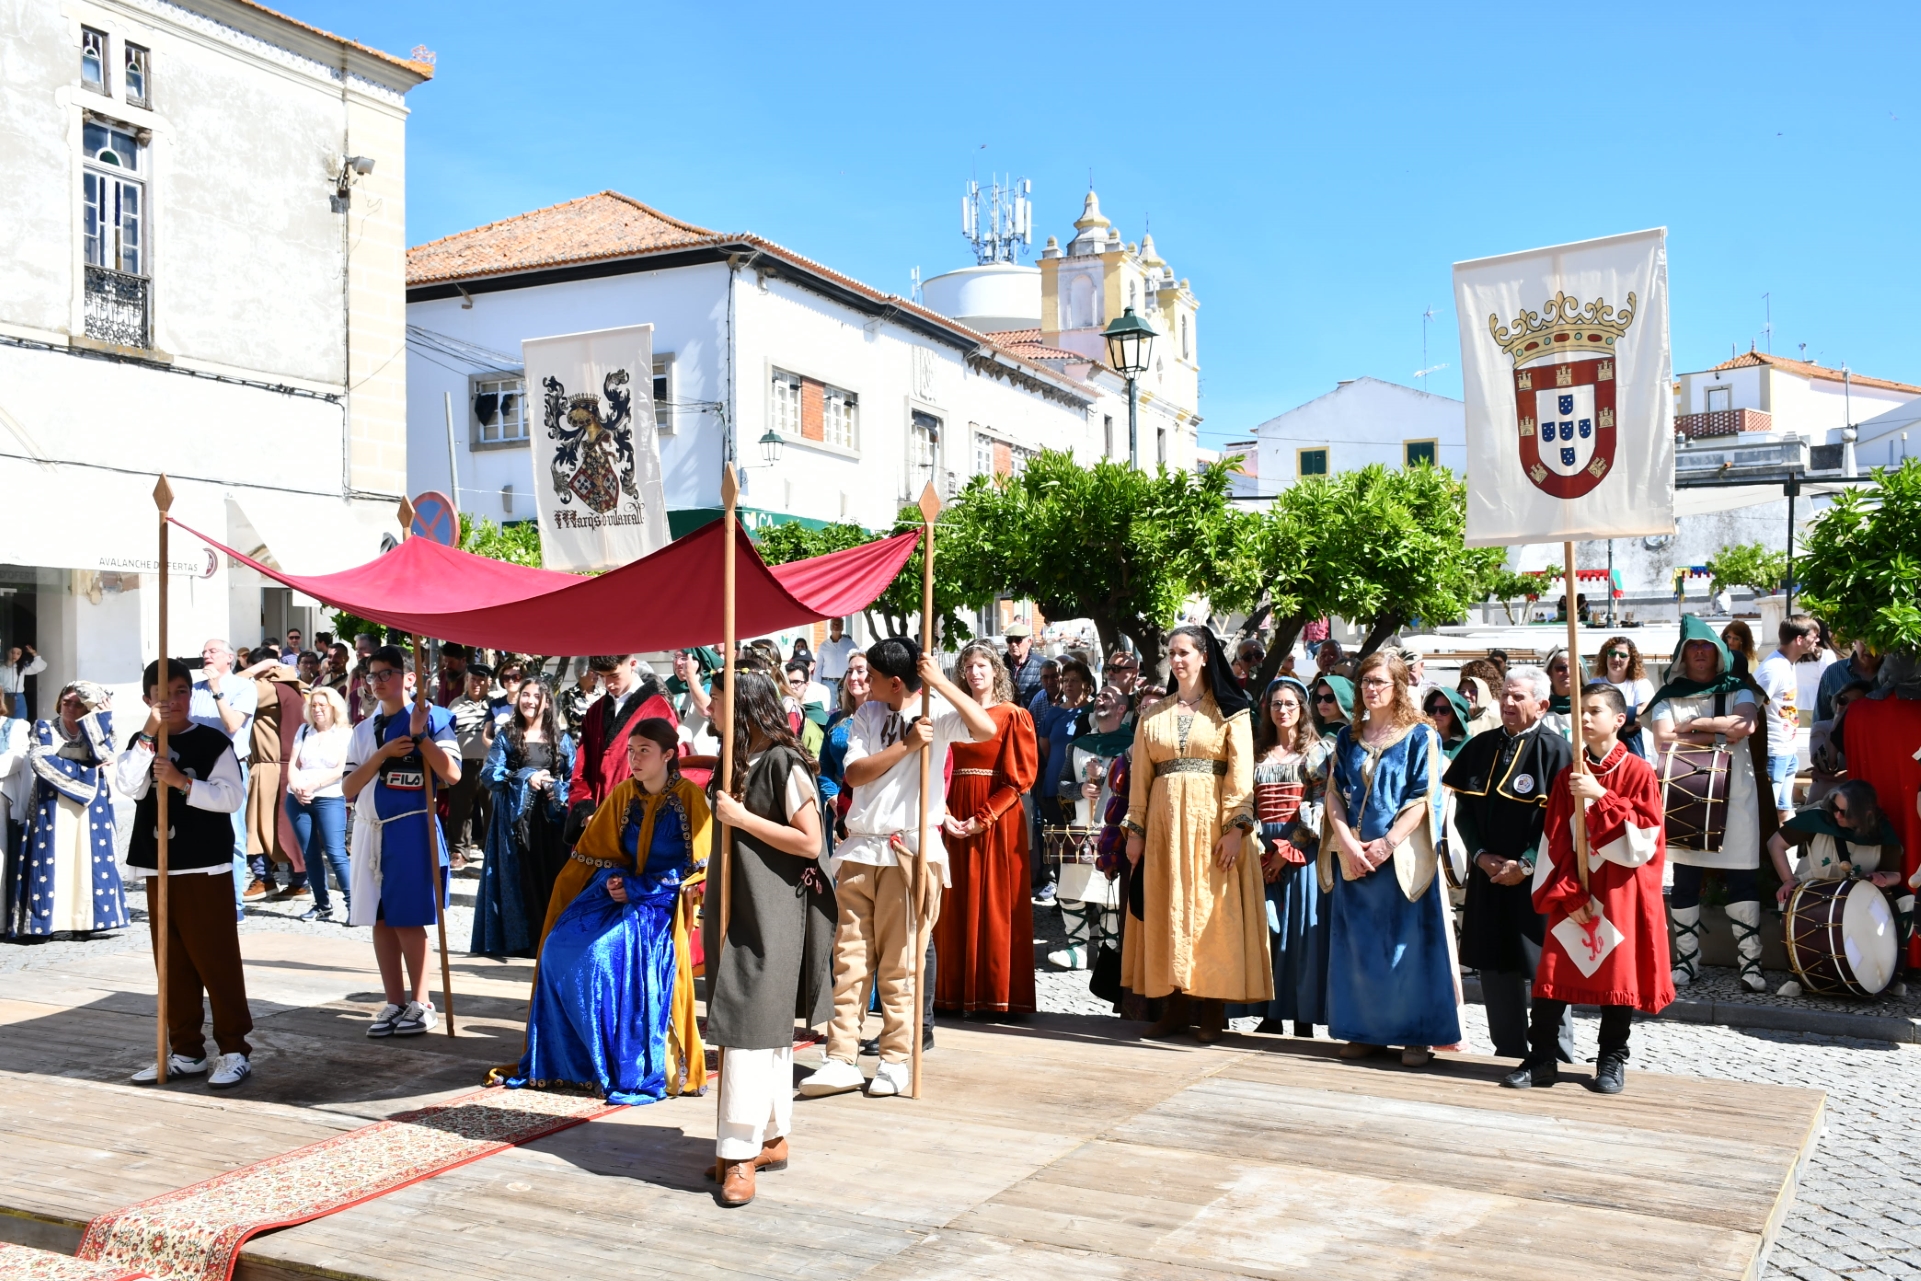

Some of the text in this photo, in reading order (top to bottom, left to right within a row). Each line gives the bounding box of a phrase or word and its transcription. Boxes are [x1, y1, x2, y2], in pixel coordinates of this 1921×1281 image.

[99, 557, 198, 572] AVALANCHE DFERTAS
[390, 773, 421, 786] FILA
